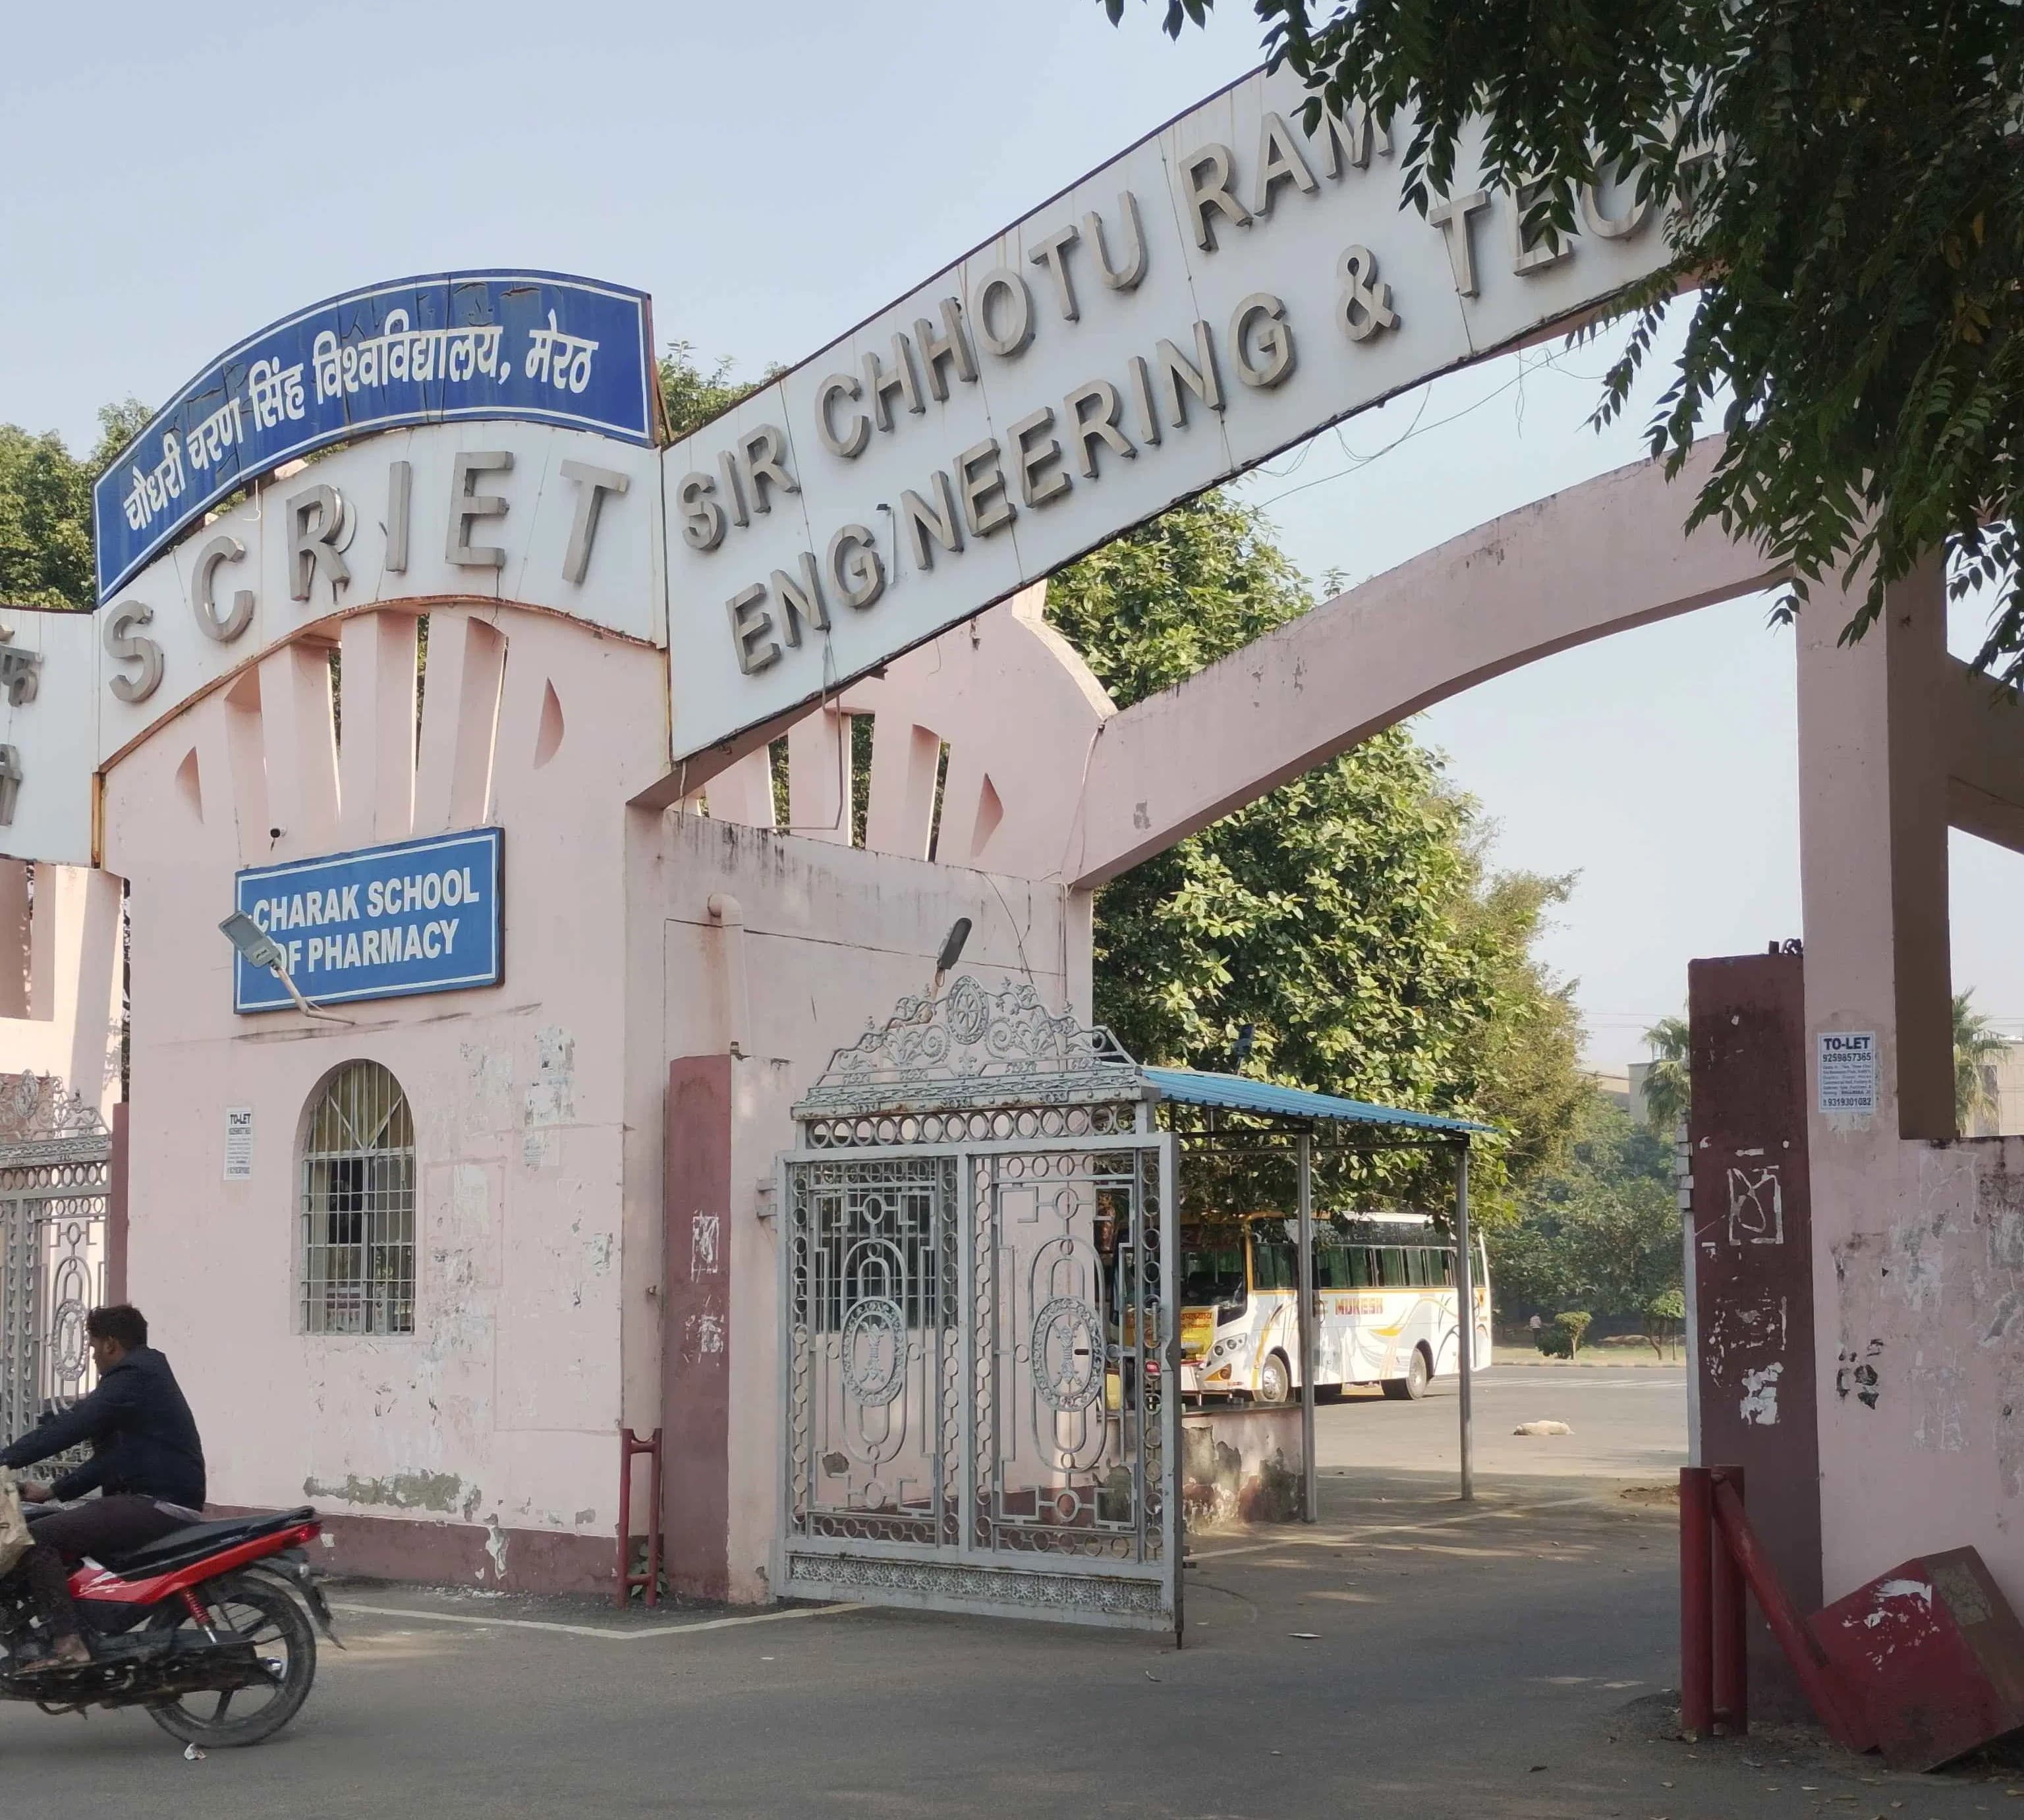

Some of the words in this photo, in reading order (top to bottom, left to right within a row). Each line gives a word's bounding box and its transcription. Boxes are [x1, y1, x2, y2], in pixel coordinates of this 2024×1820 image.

[123, 428, 185, 532] चौधरी
[186, 397, 245, 470] चरण
[248, 356, 306, 432] सिंह
[312, 308, 511, 404] विश्वविद्यालय,
[524, 309, 599, 394] मेरठ
[677, 423, 801, 552] SIR
[814, 190, 1148, 458] CHHOTU
[1179, 84, 1393, 251] RAM
[726, 292, 1296, 675] ENGINEERING
[1335, 244, 1401, 342] &
[103, 451, 629, 702] SCRIET
[253, 884, 361, 932] CHARAK
[366, 867, 480, 918] SCHOOL
[308, 918, 460, 973] PHARMACY
[1823, 1036, 1870, 1051] TO-LET
